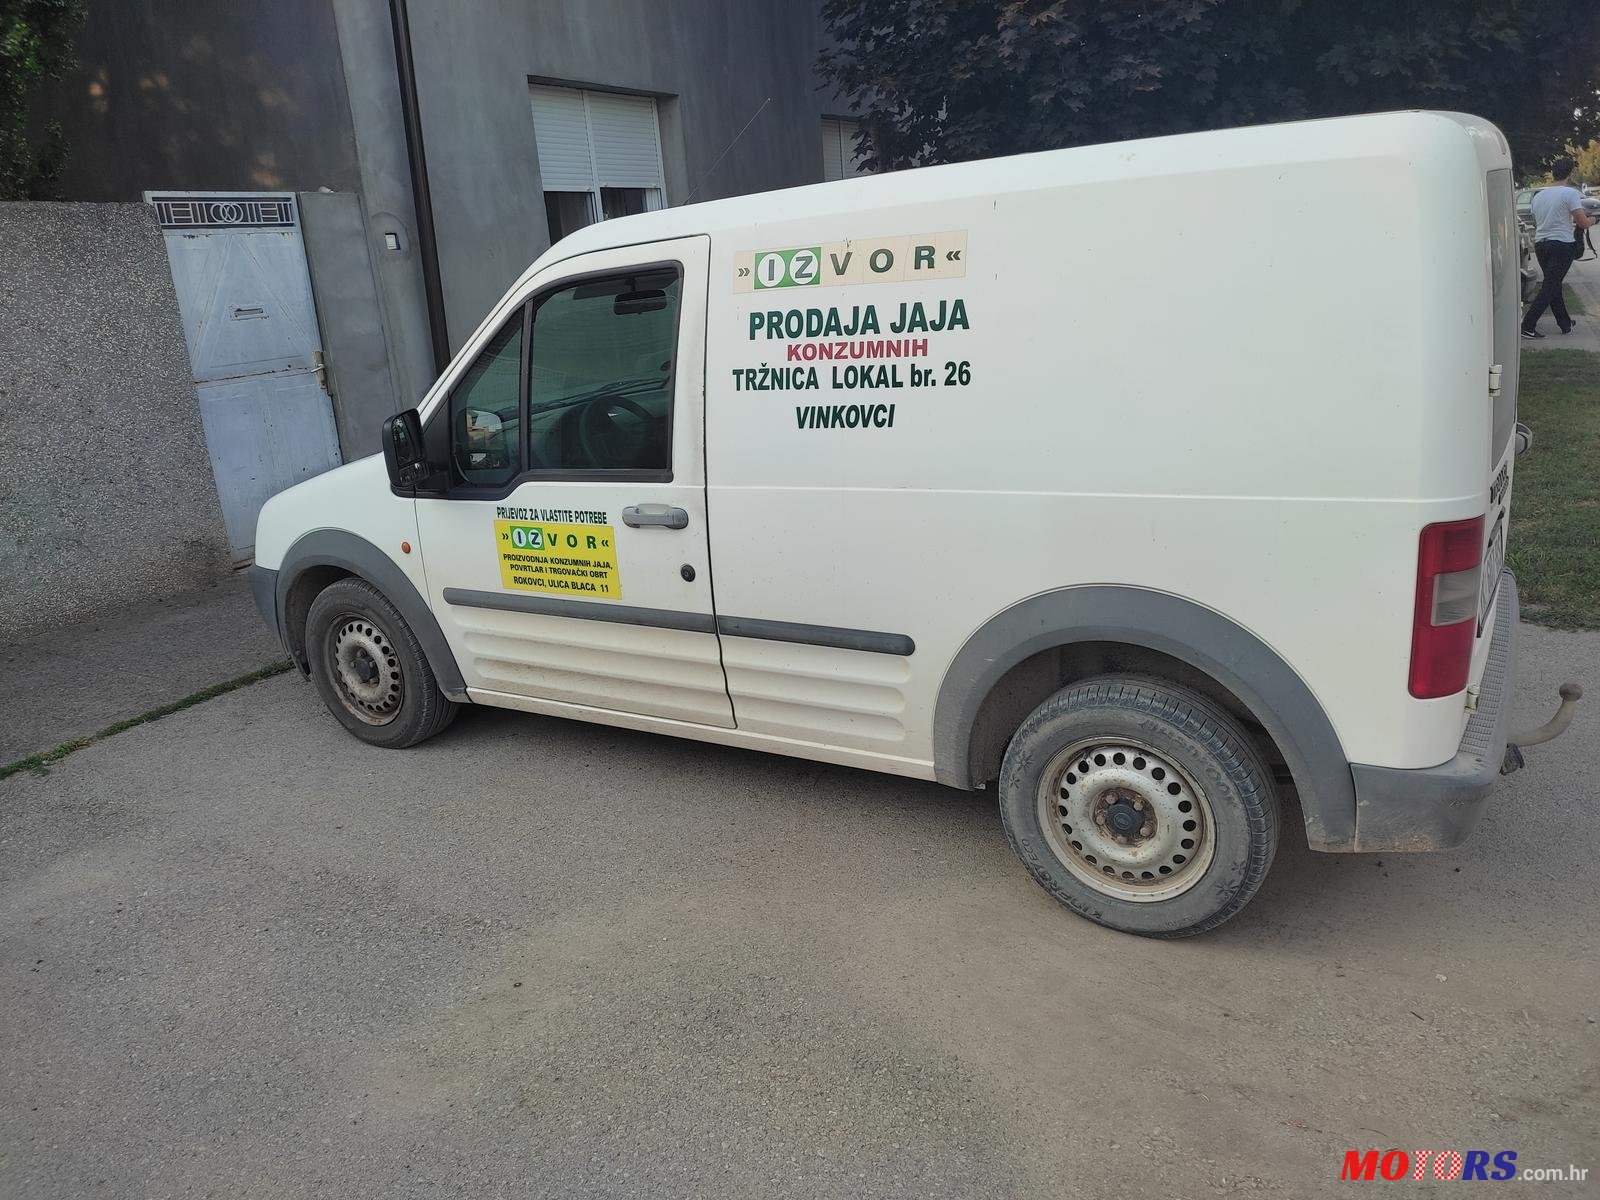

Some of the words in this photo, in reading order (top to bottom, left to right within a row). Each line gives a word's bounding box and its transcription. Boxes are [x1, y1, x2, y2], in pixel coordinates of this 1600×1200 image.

[749, 304, 881, 340] PRODAJA
[889, 299, 970, 334] JAJA
[787, 338, 928, 361] KONZUMNIH
[732, 362, 819, 391] TRŽNICA
[832, 364, 904, 389] LOKAL
[910, 363, 936, 387] br.
[943, 361, 971, 386] 26
[796, 404, 895, 429] VINKOVCI
[496, 506, 527, 520] PRIJEVOZ
[529, 508, 539, 521] ZA
[540, 509, 573, 522] VLASTITE
[574, 510, 607, 524] POTREBE
[503, 553, 549, 564] PROIZVODNJA
[549, 557, 591, 567] KONZUMNIH
[592, 560, 613, 570] JAJA,
[510, 563, 544, 573] POVRTLAR
[549, 567, 588, 577] TRGOVAČKI
[589, 570, 608, 578] OBRT
[513, 576, 547, 588] ROKOVCI,
[547, 579, 570, 589] ULICA
[571, 581, 596, 592] BLACA
[600, 584, 609, 592] 11
